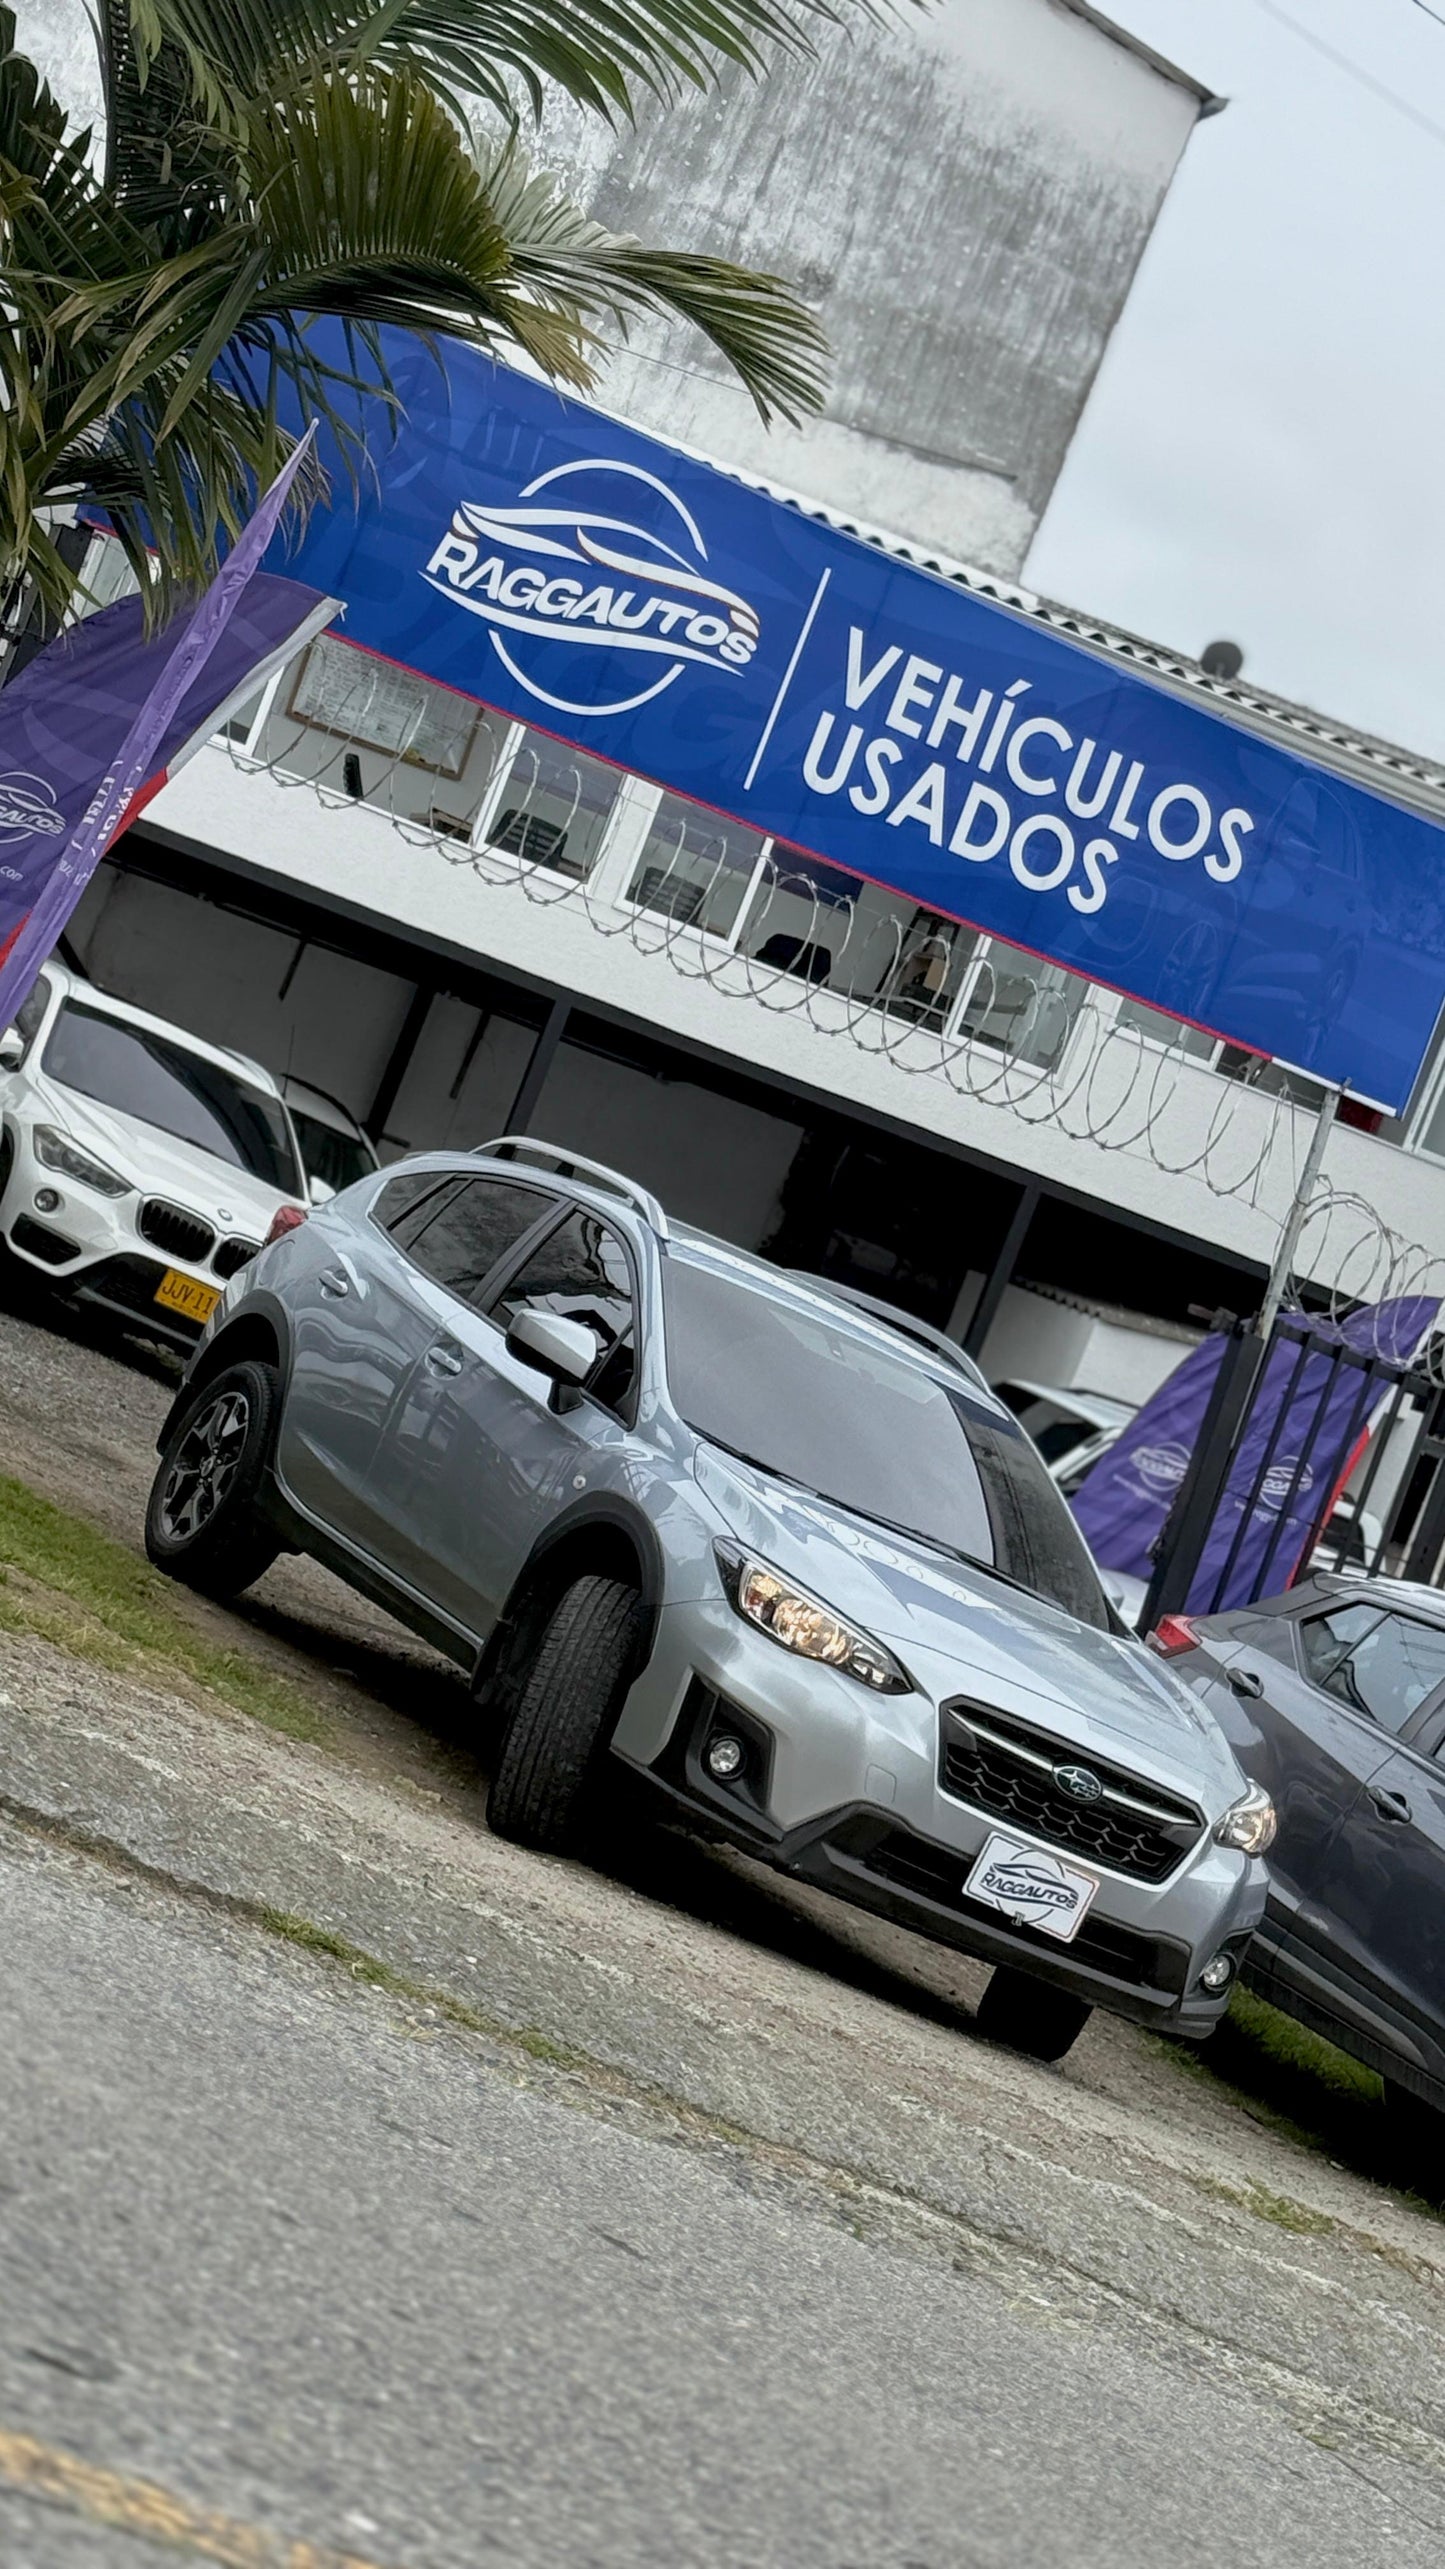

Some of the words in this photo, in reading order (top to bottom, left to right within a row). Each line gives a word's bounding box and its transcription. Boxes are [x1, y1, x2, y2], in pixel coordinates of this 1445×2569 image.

[426, 531, 757, 664] RAGGAUTOS
[803, 711, 1118, 914] USADOS
[845, 626, 1254, 882] VEHÍCULOS
[980, 1871, 1078, 1909] RAGGAUTOS
